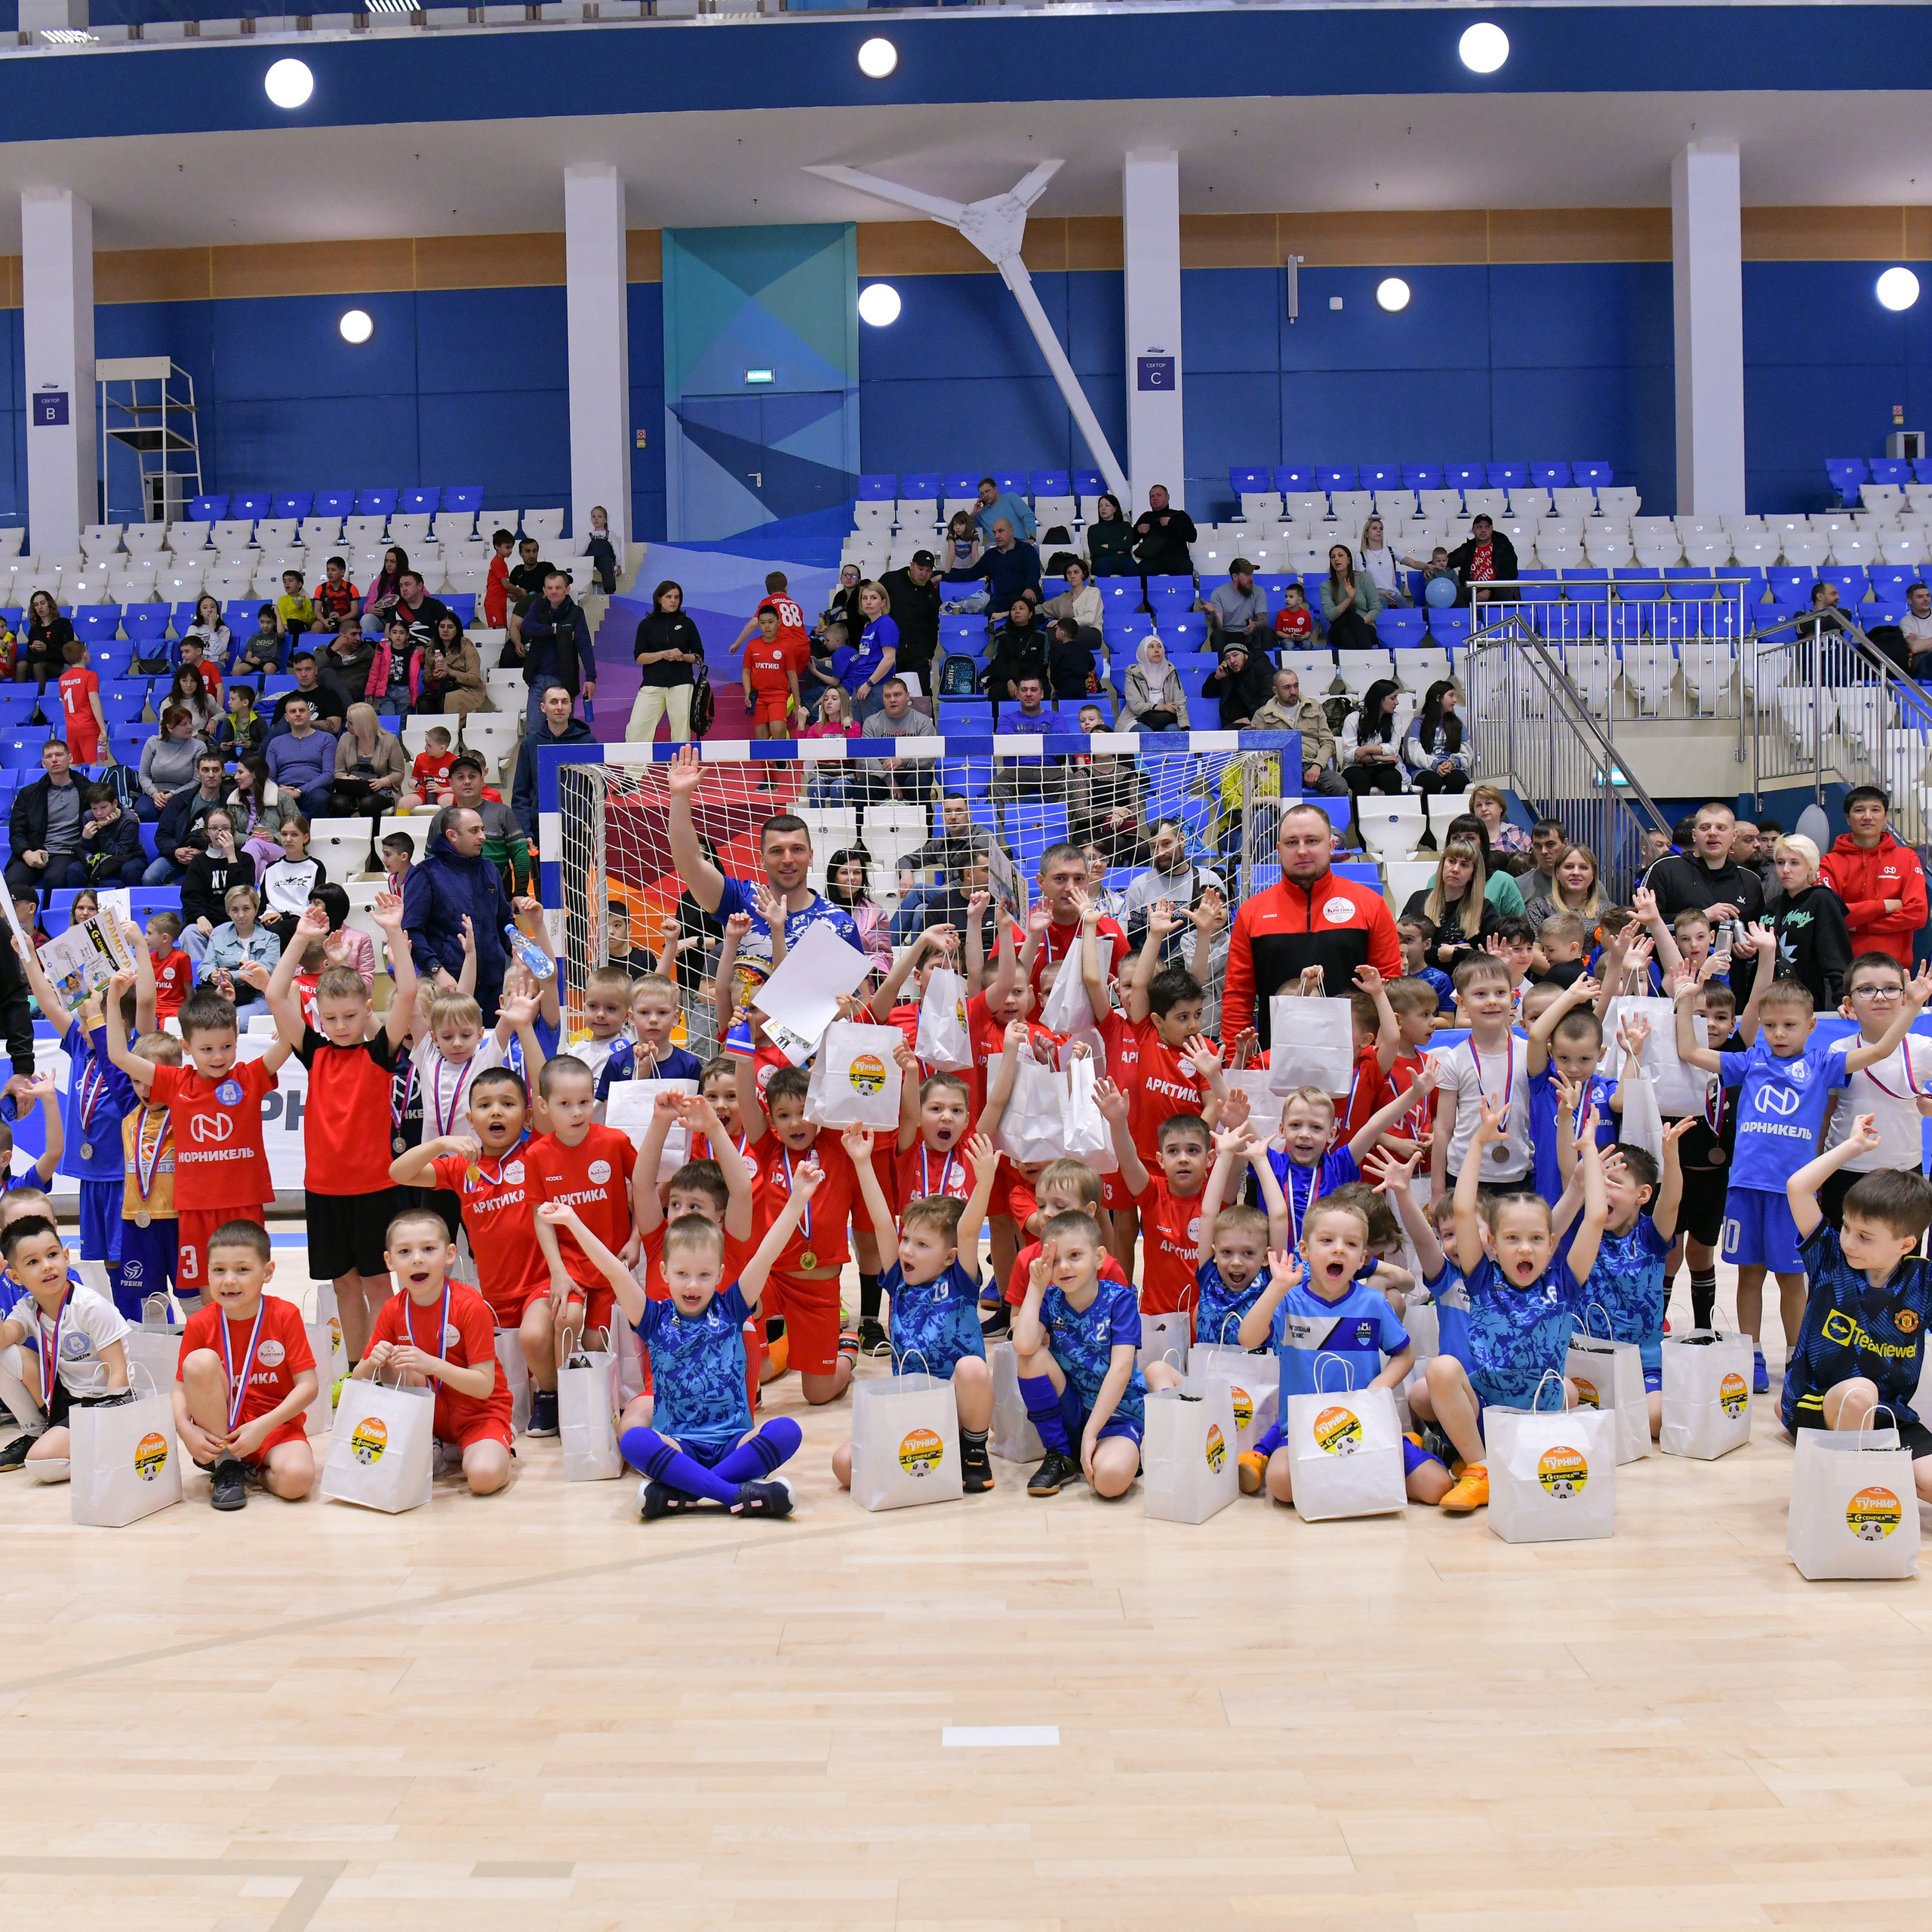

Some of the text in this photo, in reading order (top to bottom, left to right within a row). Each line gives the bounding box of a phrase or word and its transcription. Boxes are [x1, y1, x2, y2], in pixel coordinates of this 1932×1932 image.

[780, 603, 803, 627] 88
[63, 688, 75, 713] 1
[211, 870, 228, 888] NY
[104, 911, 132, 970] ГРАМОТА
[855, 1063, 882, 1072] ТУРНИР
[178, 1147, 255, 1163] НОРНИКЕЛЬ
[473, 1189, 525, 1214] АРКТИКА
[553, 1188, 608, 1208] АРКТИКА
[1159, 1239, 1199, 1260] АРКТИК
[180, 1245, 199, 1279] 3
[933, 1281, 949, 1302] 19
[1854, 1327, 1918, 1359] TeaViewer
[1721, 1382, 1744, 1395] ТУРНИР
[361, 1425, 386, 1439] ТУРНИР
[1316, 1411, 1348, 1435] ТУРНИР
[139, 1441, 165, 1455] ТУРНИР
[905, 1438, 939, 1451] ТУРНИР
[1544, 1457, 1582, 1469] ТУРНИР
[1857, 1499, 1897, 1510] ТУРНИР
